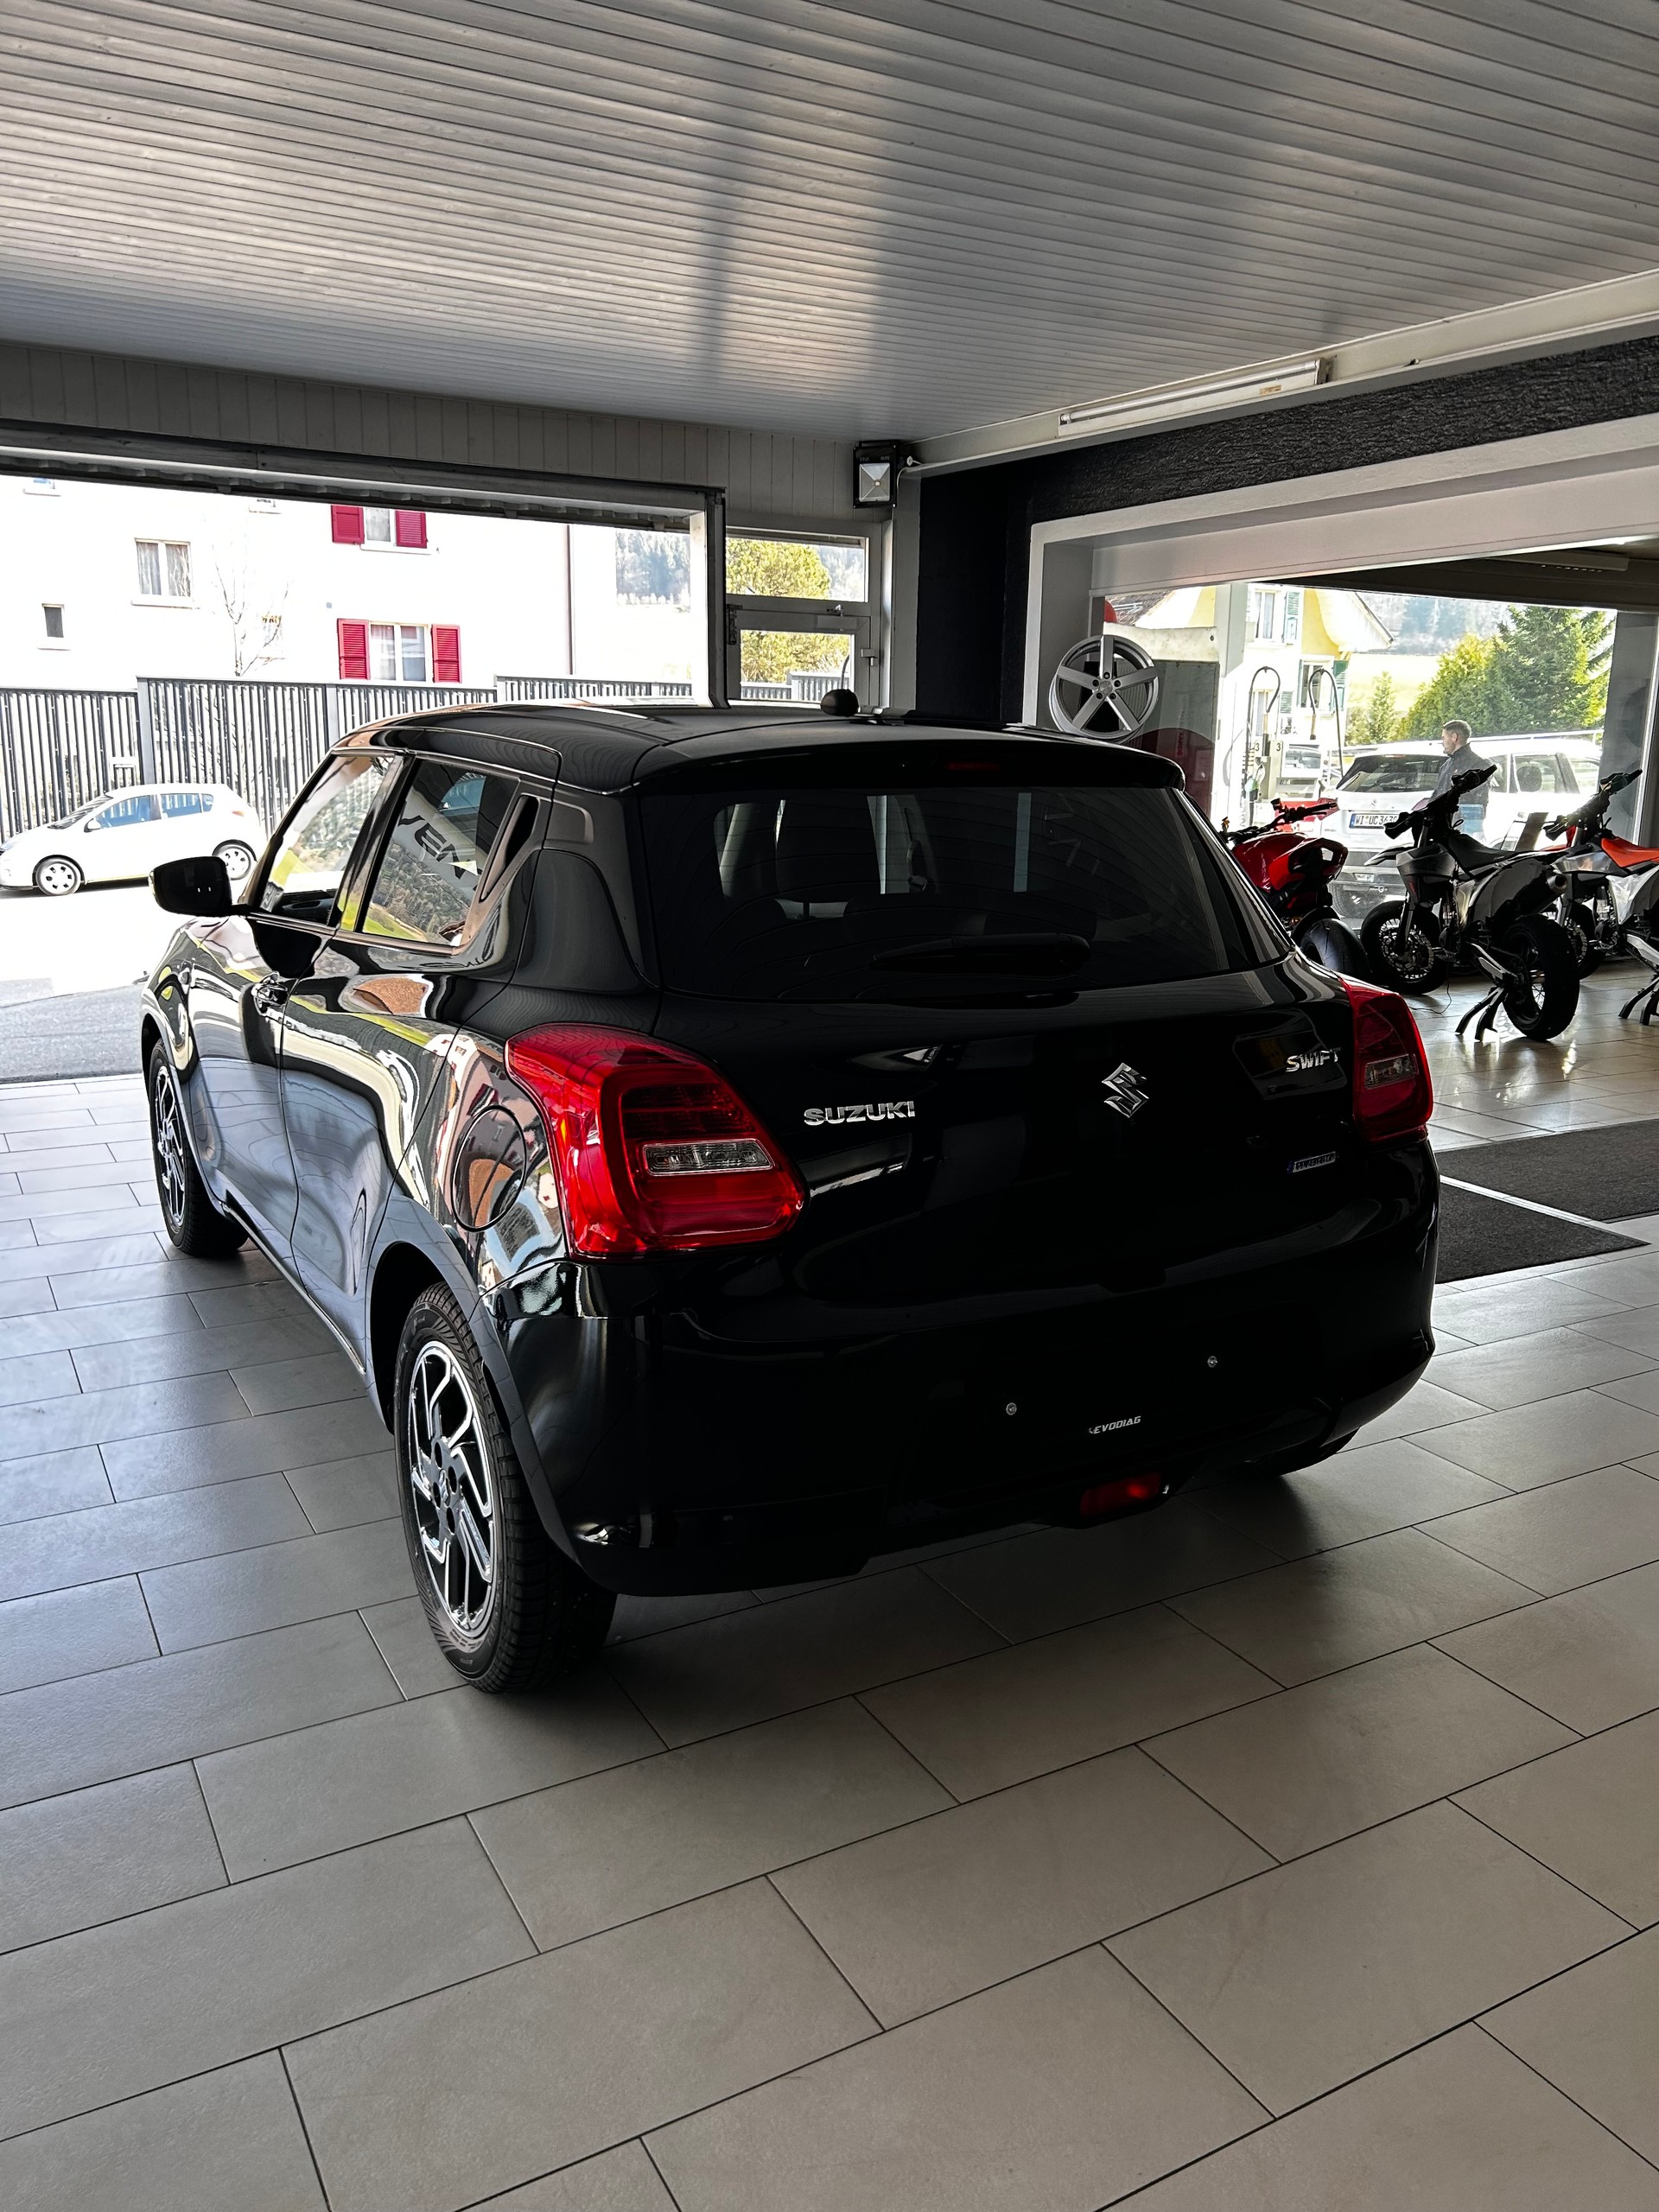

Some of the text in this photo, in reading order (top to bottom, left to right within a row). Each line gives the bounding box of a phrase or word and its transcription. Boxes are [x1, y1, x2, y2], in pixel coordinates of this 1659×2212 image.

[1276, 742, 1281, 752] 3
[1355, 816, 1364, 825] WI
[1286, 1047, 1341, 1072] SWIFT
[804, 1101, 915, 1126] SUZUKI
